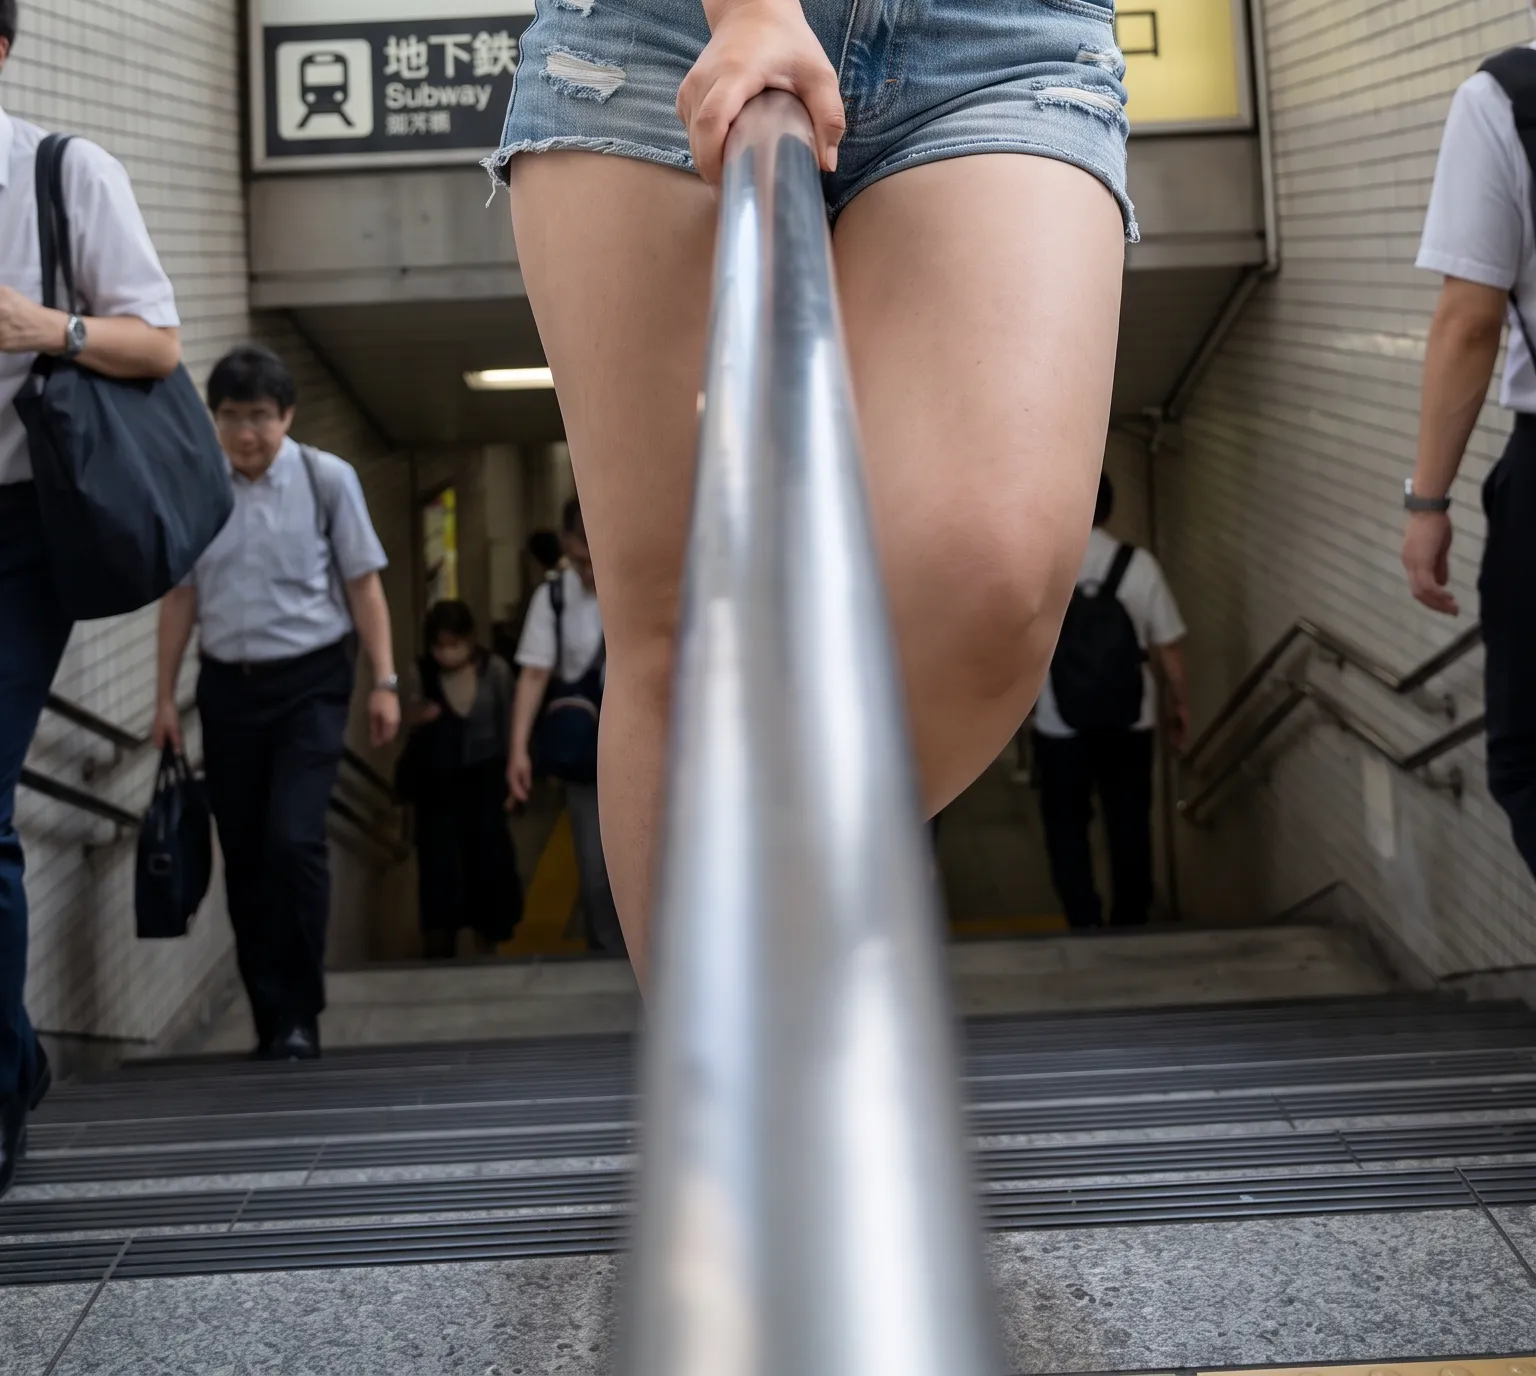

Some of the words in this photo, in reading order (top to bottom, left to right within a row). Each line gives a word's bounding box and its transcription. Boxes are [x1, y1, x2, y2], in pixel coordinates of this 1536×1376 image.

[383, 30, 518, 80] 地下鉄
[384, 81, 492, 112] Subway
